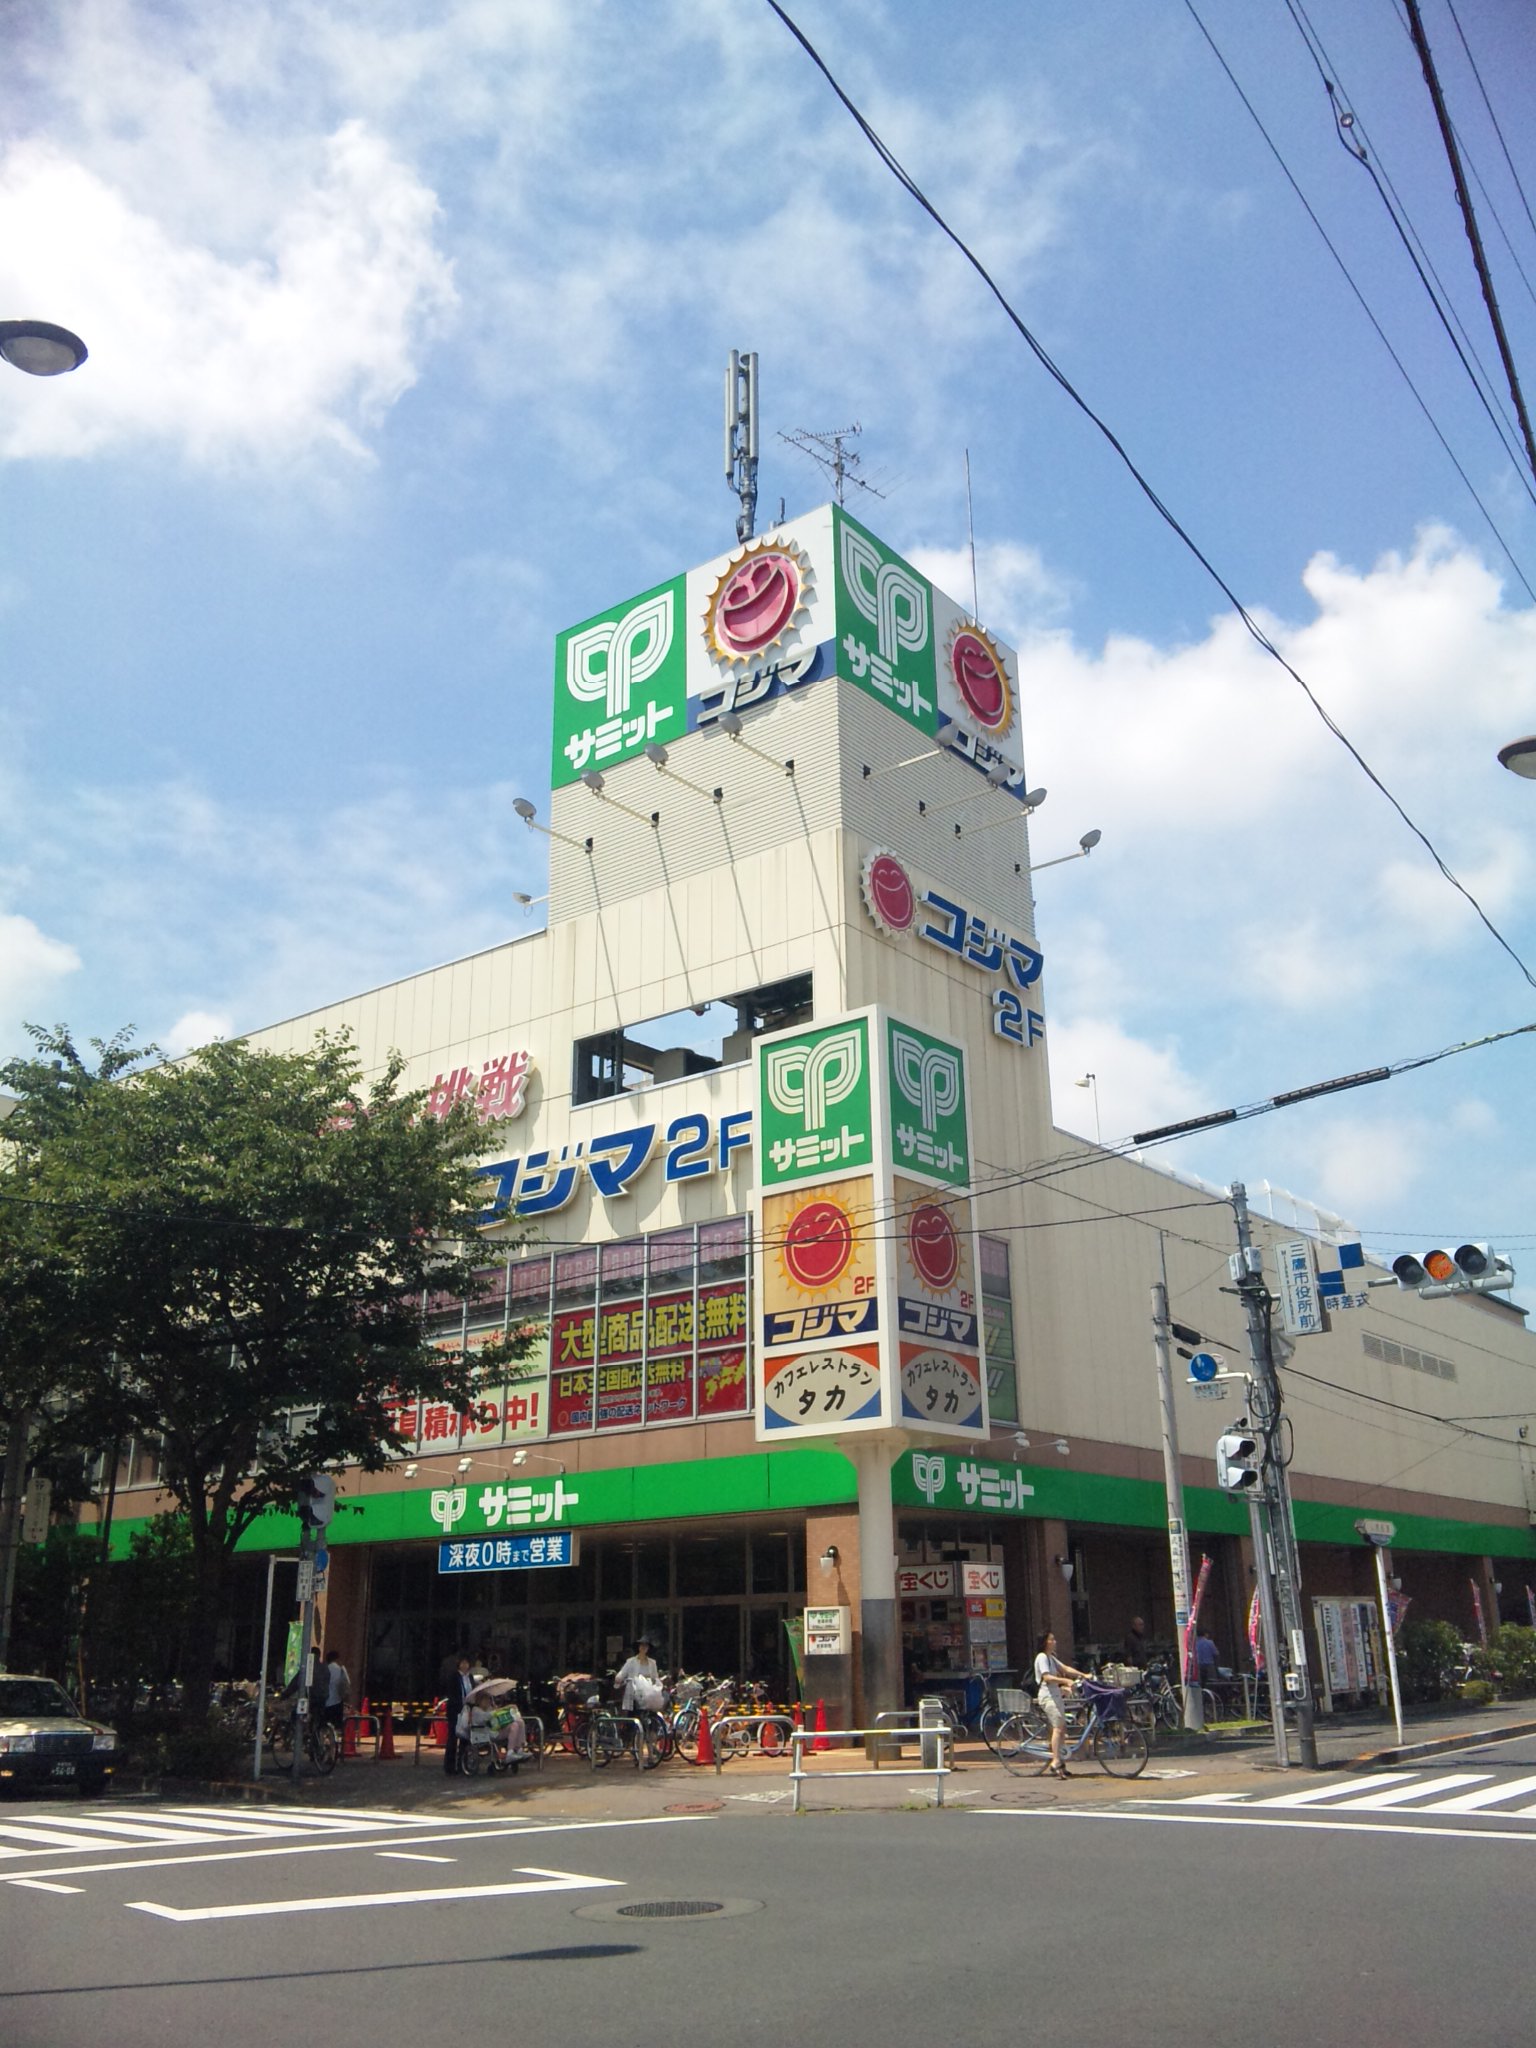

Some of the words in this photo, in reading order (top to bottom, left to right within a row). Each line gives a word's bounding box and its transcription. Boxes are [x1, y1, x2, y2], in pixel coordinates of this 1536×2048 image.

[697, 646, 817, 724] コジマ
[843, 633, 932, 717] サミット
[564, 700, 673, 769] サミット
[918, 890, 1044, 990] コジマ
[993, 989, 1044, 1048] 2F
[769, 1125, 865, 1172] サミット
[896, 1123, 964, 1173] サミット
[854, 1276, 875, 1295] 2F
[960, 1290, 974, 1309] 2F
[1290, 1243, 1316, 1329] 三鷹市役所前
[1326, 1292, 1370, 1311] 時差式
[772, 1301, 870, 1343] コジマ
[903, 1301, 971, 1341] コジマ
[799, 1385, 846, 1415] タカ
[926, 1384, 959, 1414] タカ
[479, 1480, 579, 1527] サミット
[957, 1462, 1035, 1510] サミット
[448, 1536, 563, 1568] 深夜0時まで営業
[900, 1570, 949, 1592] 宝くじ
[967, 1570, 1000, 1590] 宝くじ
